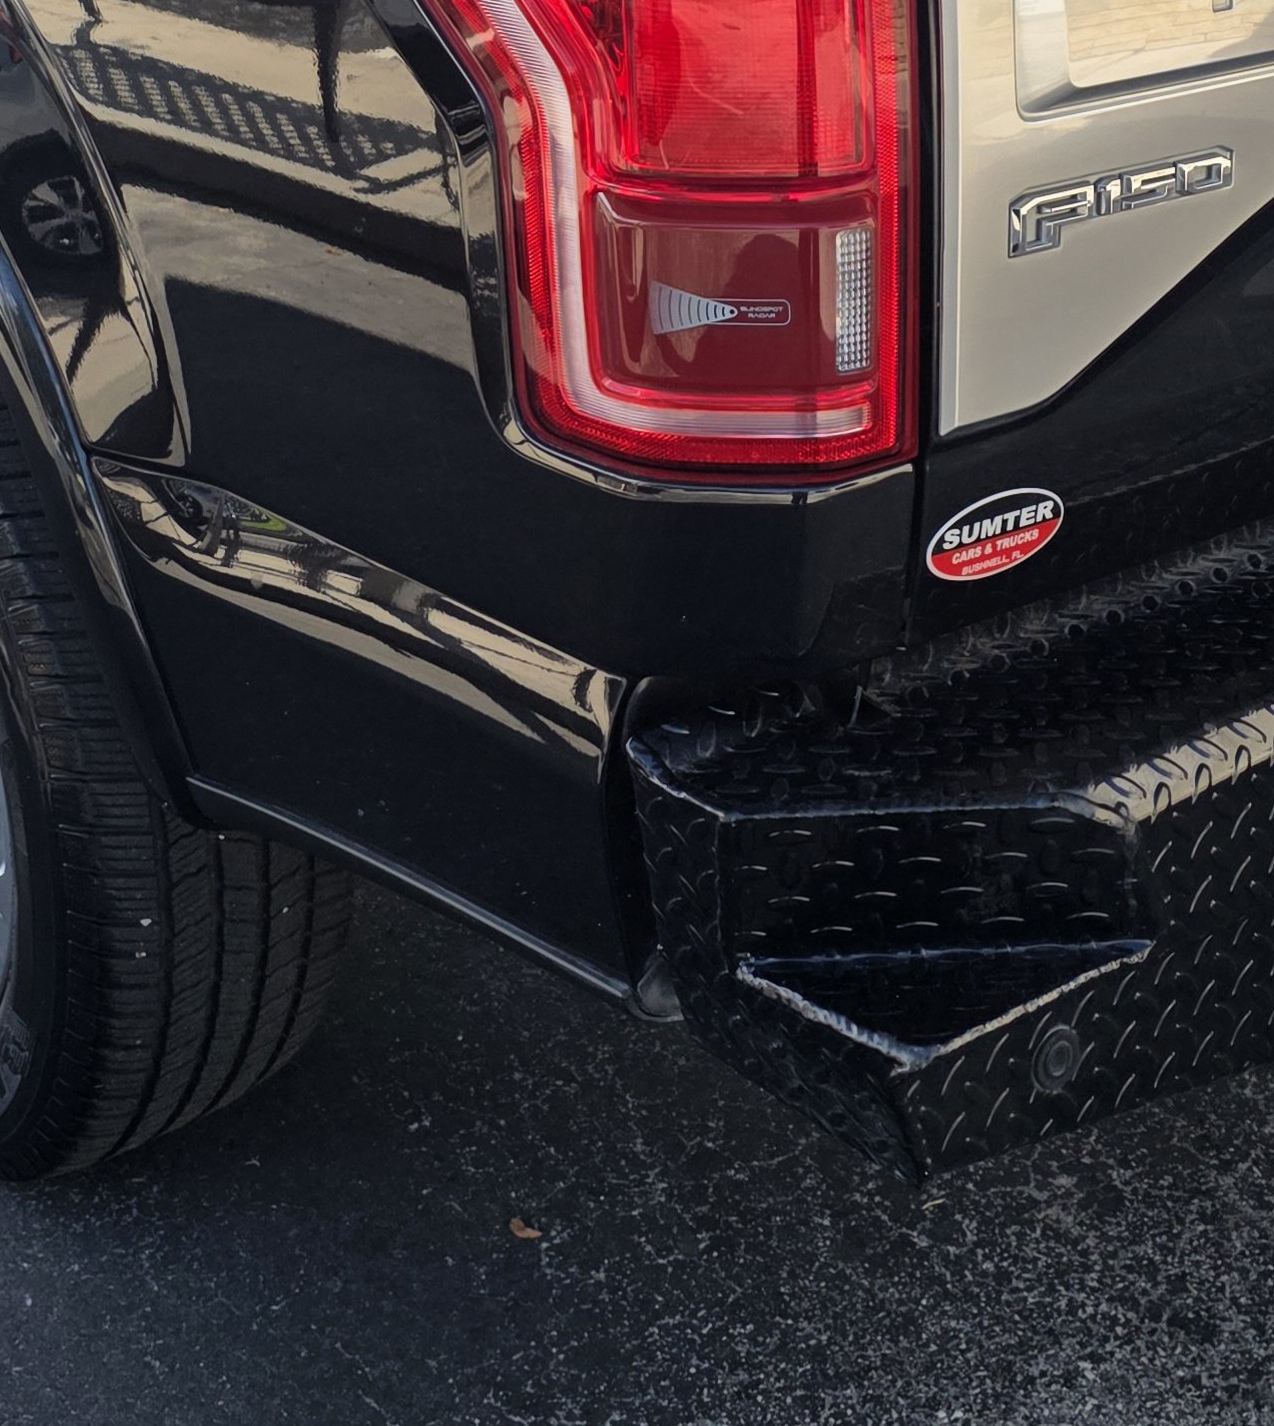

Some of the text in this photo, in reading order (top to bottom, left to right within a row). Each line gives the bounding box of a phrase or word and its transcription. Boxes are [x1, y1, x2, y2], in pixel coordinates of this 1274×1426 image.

[942, 500, 1055, 550] SUMTER
[952, 529, 1039, 564] CARS & TRUCKS
